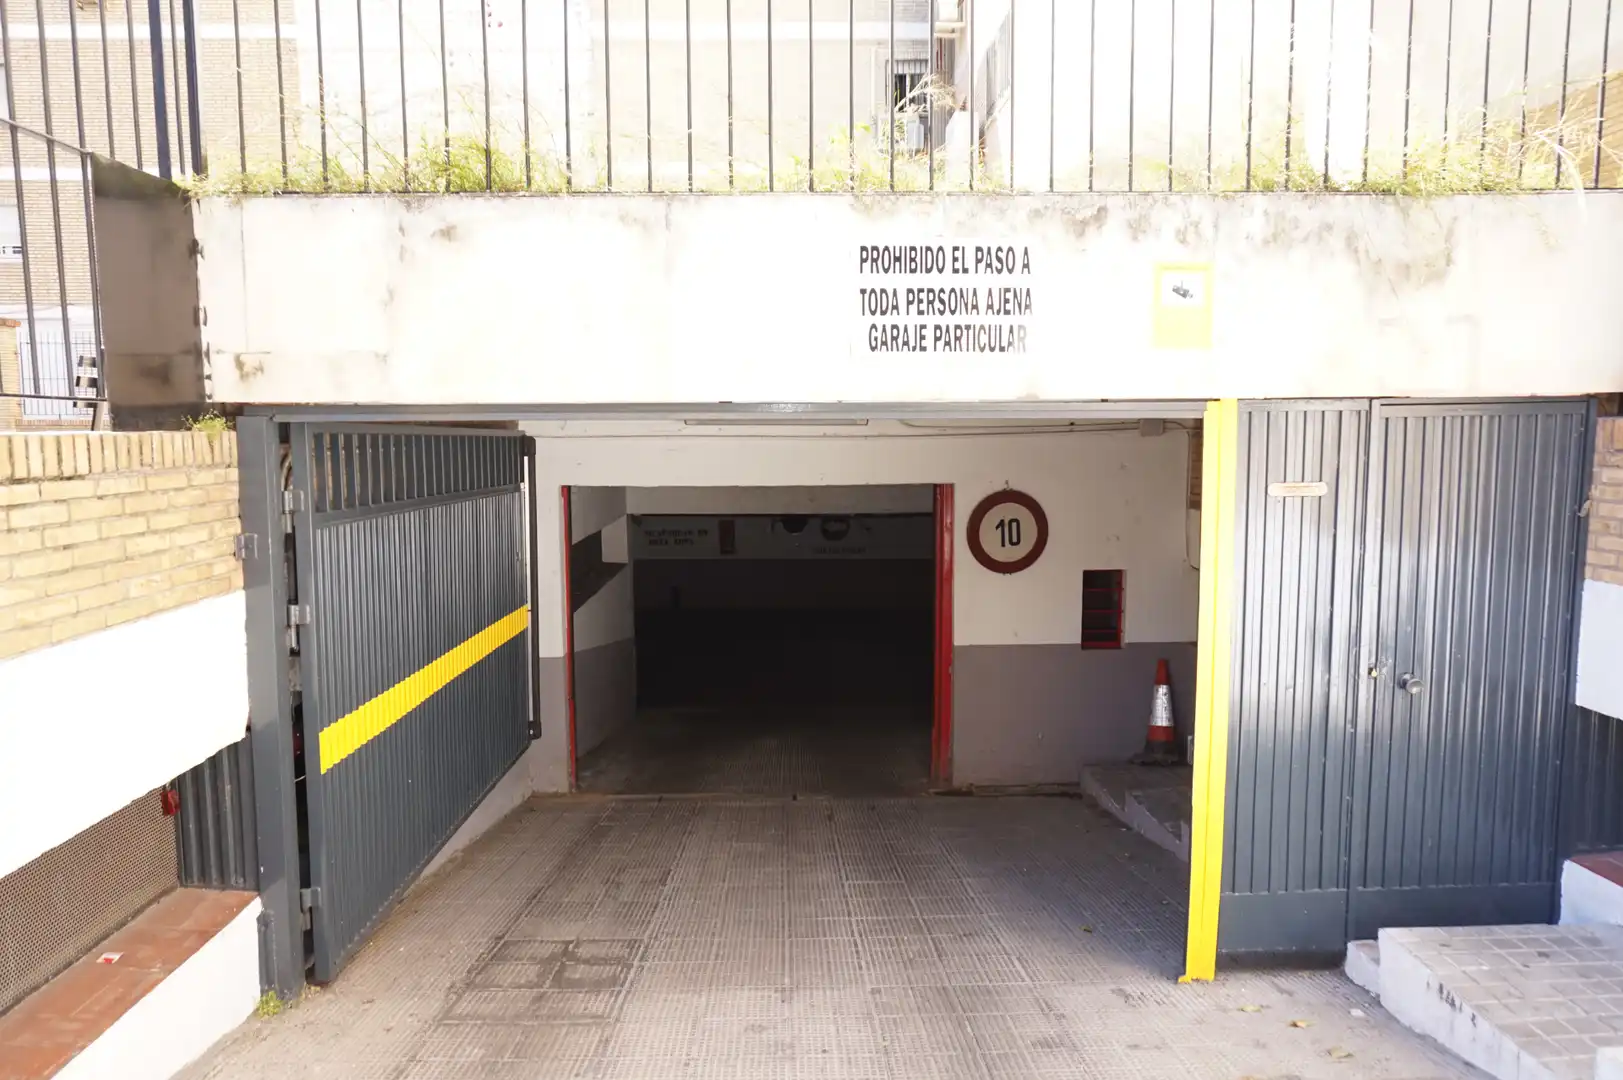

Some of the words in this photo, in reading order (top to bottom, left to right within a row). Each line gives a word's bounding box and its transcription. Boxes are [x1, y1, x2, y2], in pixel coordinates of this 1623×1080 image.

[860, 245, 946, 275] PROHIBIDO
[952, 245, 969, 274] EL
[975, 246, 1016, 275] PASO
[1021, 246, 1031, 274] A
[859, 288, 900, 316] TODA
[906, 288, 979, 316] PERSONA
[985, 288, 1032, 316] AJENA
[868, 323, 927, 352] GARAJE
[933, 324, 1027, 353] PARTICULAR
[995, 518, 1021, 548] 10
